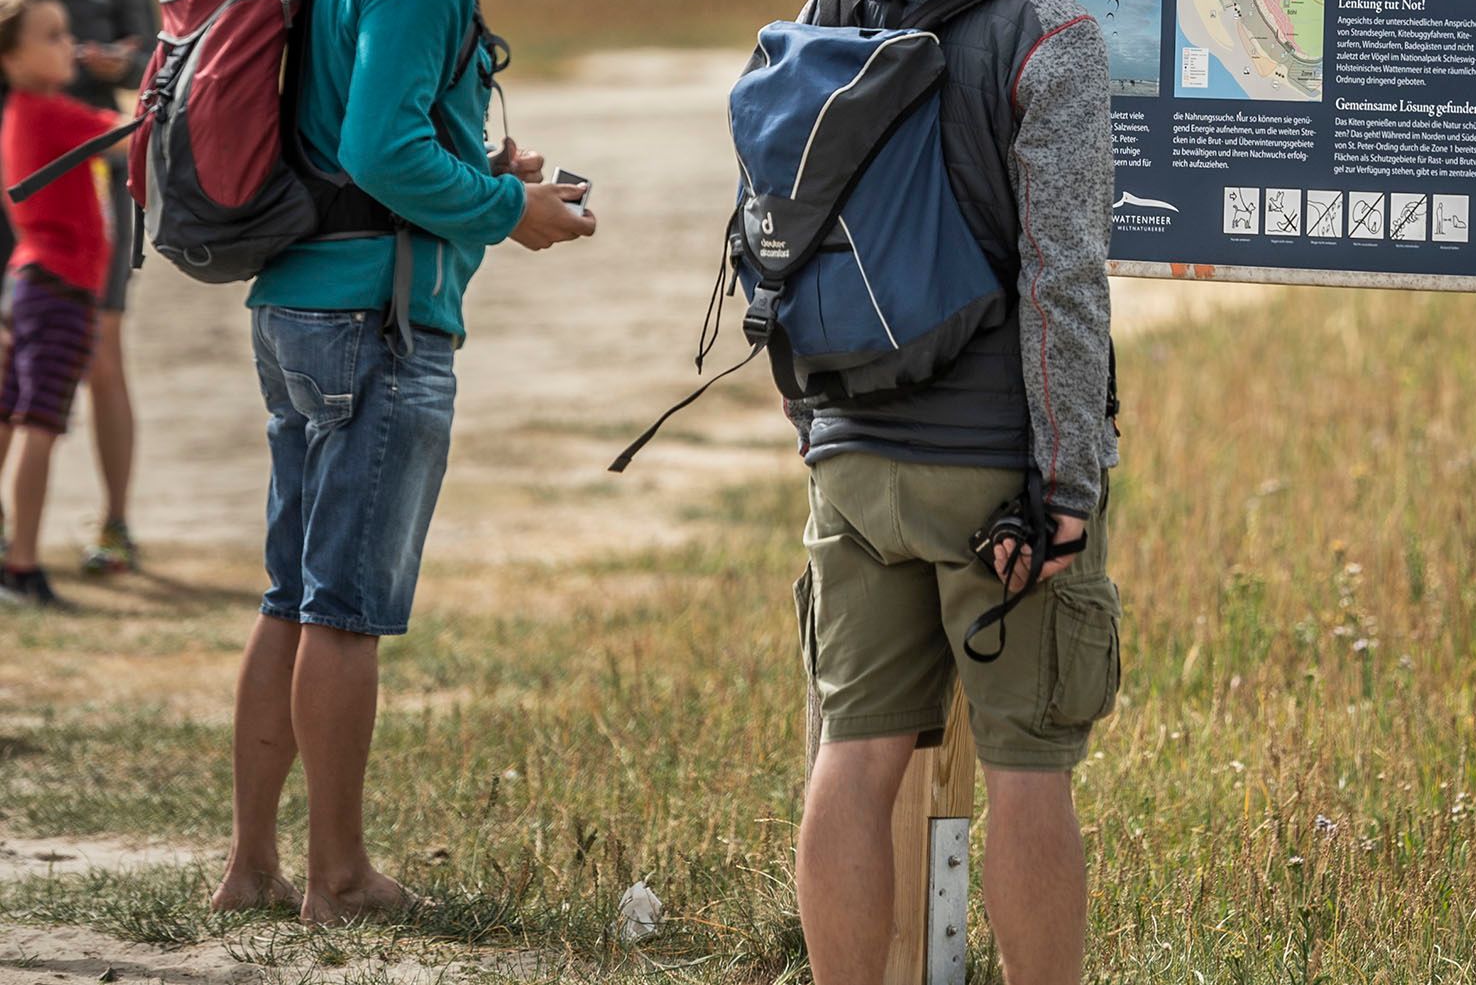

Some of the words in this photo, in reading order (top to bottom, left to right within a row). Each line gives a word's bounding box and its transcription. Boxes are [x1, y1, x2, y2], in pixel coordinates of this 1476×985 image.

[1385, 1, 1399, 9] tut
[1338, 16, 1372, 27] Angesichts
[1374, 17, 1384, 25] der
[1386, 17, 1443, 27] unterschiedlichen
[1351, 28, 1396, 39] Strandseglern,
[1398, 29, 1455, 41] Kitebuggyfahrern,
[1457, 31, 1472, 39] Kite-
[1337, 39, 1361, 48] surfern,
[1362, 40, 1403, 50] Windsurfern,
[1405, 41, 1442, 52] Badegästen
[1443, 43, 1456, 51] und
[1458, 43, 1474, 51] nicht
[1337, 51, 1358, 60] zuletzt
[1359, 52, 1370, 60] der
[1371, 52, 1389, 63] Vögel
[1401, 53, 1441, 63] Nationalpark
[1443, 54, 1476, 65] Schleswig-
[1336, 63, 1382, 72] Holsteinisches
[1383, 65, 1422, 73] Wattenmeer
[1432, 66, 1446, 74] eine
[1336, 75, 1365, 86] Ordnung
[1366, 76, 1396, 87] dringend
[1397, 77, 1426, 88] geboten.
[1336, 97, 1397, 111] Gemeinsame
[1400, 100, 1435, 117] Lösung
[1130, 112, 1144, 120] viele
[1174, 112, 1183, 120] die
[1185, 113, 1235, 124] Nahrungssuche.
[1236, 114, 1248, 122] Nur
[1258, 115, 1282, 123] können
[1293, 116, 1312, 126] genü-
[1114, 123, 1149, 132] Salzwiesen,
[1335, 117, 1347, 126] Das
[1348, 118, 1365, 126] Kiten
[1366, 118, 1396, 129] genießen
[1412, 120, 1430, 128] dabei
[1431, 120, 1442, 128] die
[1443, 121, 1461, 129] Natur
[1173, 124, 1190, 134] gend
[1191, 124, 1215, 135] Energie
[1216, 125, 1254, 134] aufnehmen,
[1267, 127, 1277, 135] die
[1278, 127, 1300, 135] weiten
[1301, 128, 1317, 136] Stre-
[1335, 129, 1349, 137] zen?
[1351, 130, 1362, 138] Das
[1364, 130, 1381, 140] geht!
[1382, 131, 1411, 139] Während
[1422, 132, 1446, 141] Norden
[1447, 133, 1460, 141] und
[1120, 135, 1138, 143] Peter-
[1173, 136, 1188, 144] cken
[1197, 136, 1207, 144] die
[1208, 137, 1223, 145] Brut-
[1225, 137, 1237, 145] und
[1239, 136, 1314, 150] Überwinterungsgebiete
[1120, 146, 1140, 156] ruhige
[1182, 148, 1217, 158] bewältigen
[1218, 149, 1231, 157] und
[1232, 149, 1248, 157] ihren
[1250, 150, 1286, 159] Nachwuchs
[1287, 151, 1310, 161] erfolg-
[1129, 158, 1141, 166] und
[1143, 159, 1151, 167] für
[1173, 159, 1188, 167] reich
[1189, 159, 1229, 168] aufzuziehen.
[1112, 215, 1171, 225] WATTENMEER
